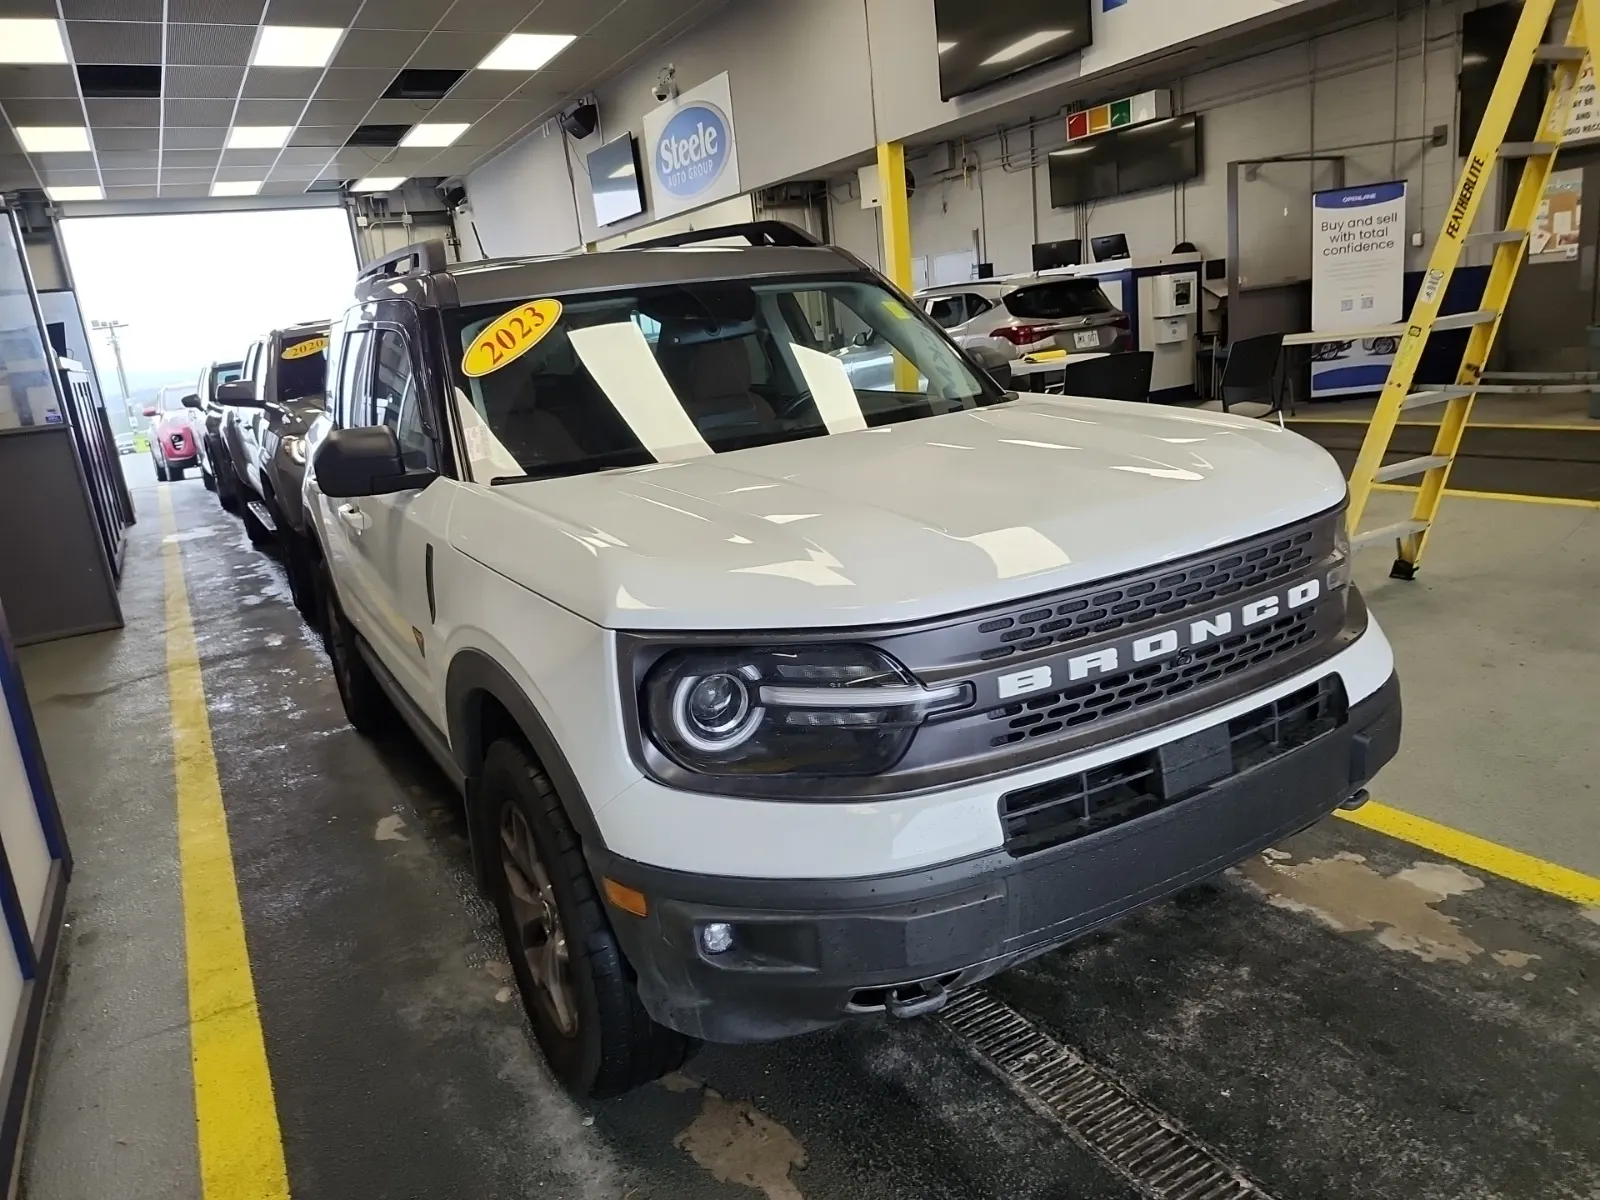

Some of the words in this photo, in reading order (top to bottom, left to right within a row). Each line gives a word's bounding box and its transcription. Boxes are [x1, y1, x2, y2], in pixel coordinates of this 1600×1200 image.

[660, 122, 718, 174] Steele
[668, 171, 687, 188] AUTO
[688, 159, 713, 179] GROUP
[1445, 155, 1485, 239] FEATHERLITE
[1321, 221, 1344, 232] Buy
[1347, 216, 1373, 228] and
[1376, 212, 1398, 225] sell
[1329, 230, 1355, 243] with
[1360, 226, 1389, 239] total
[1323, 240, 1395, 256] confidence
[292, 340, 324, 357] 2020
[480, 306, 545, 365] 2023
[997, 577, 1321, 700] BRONCO
